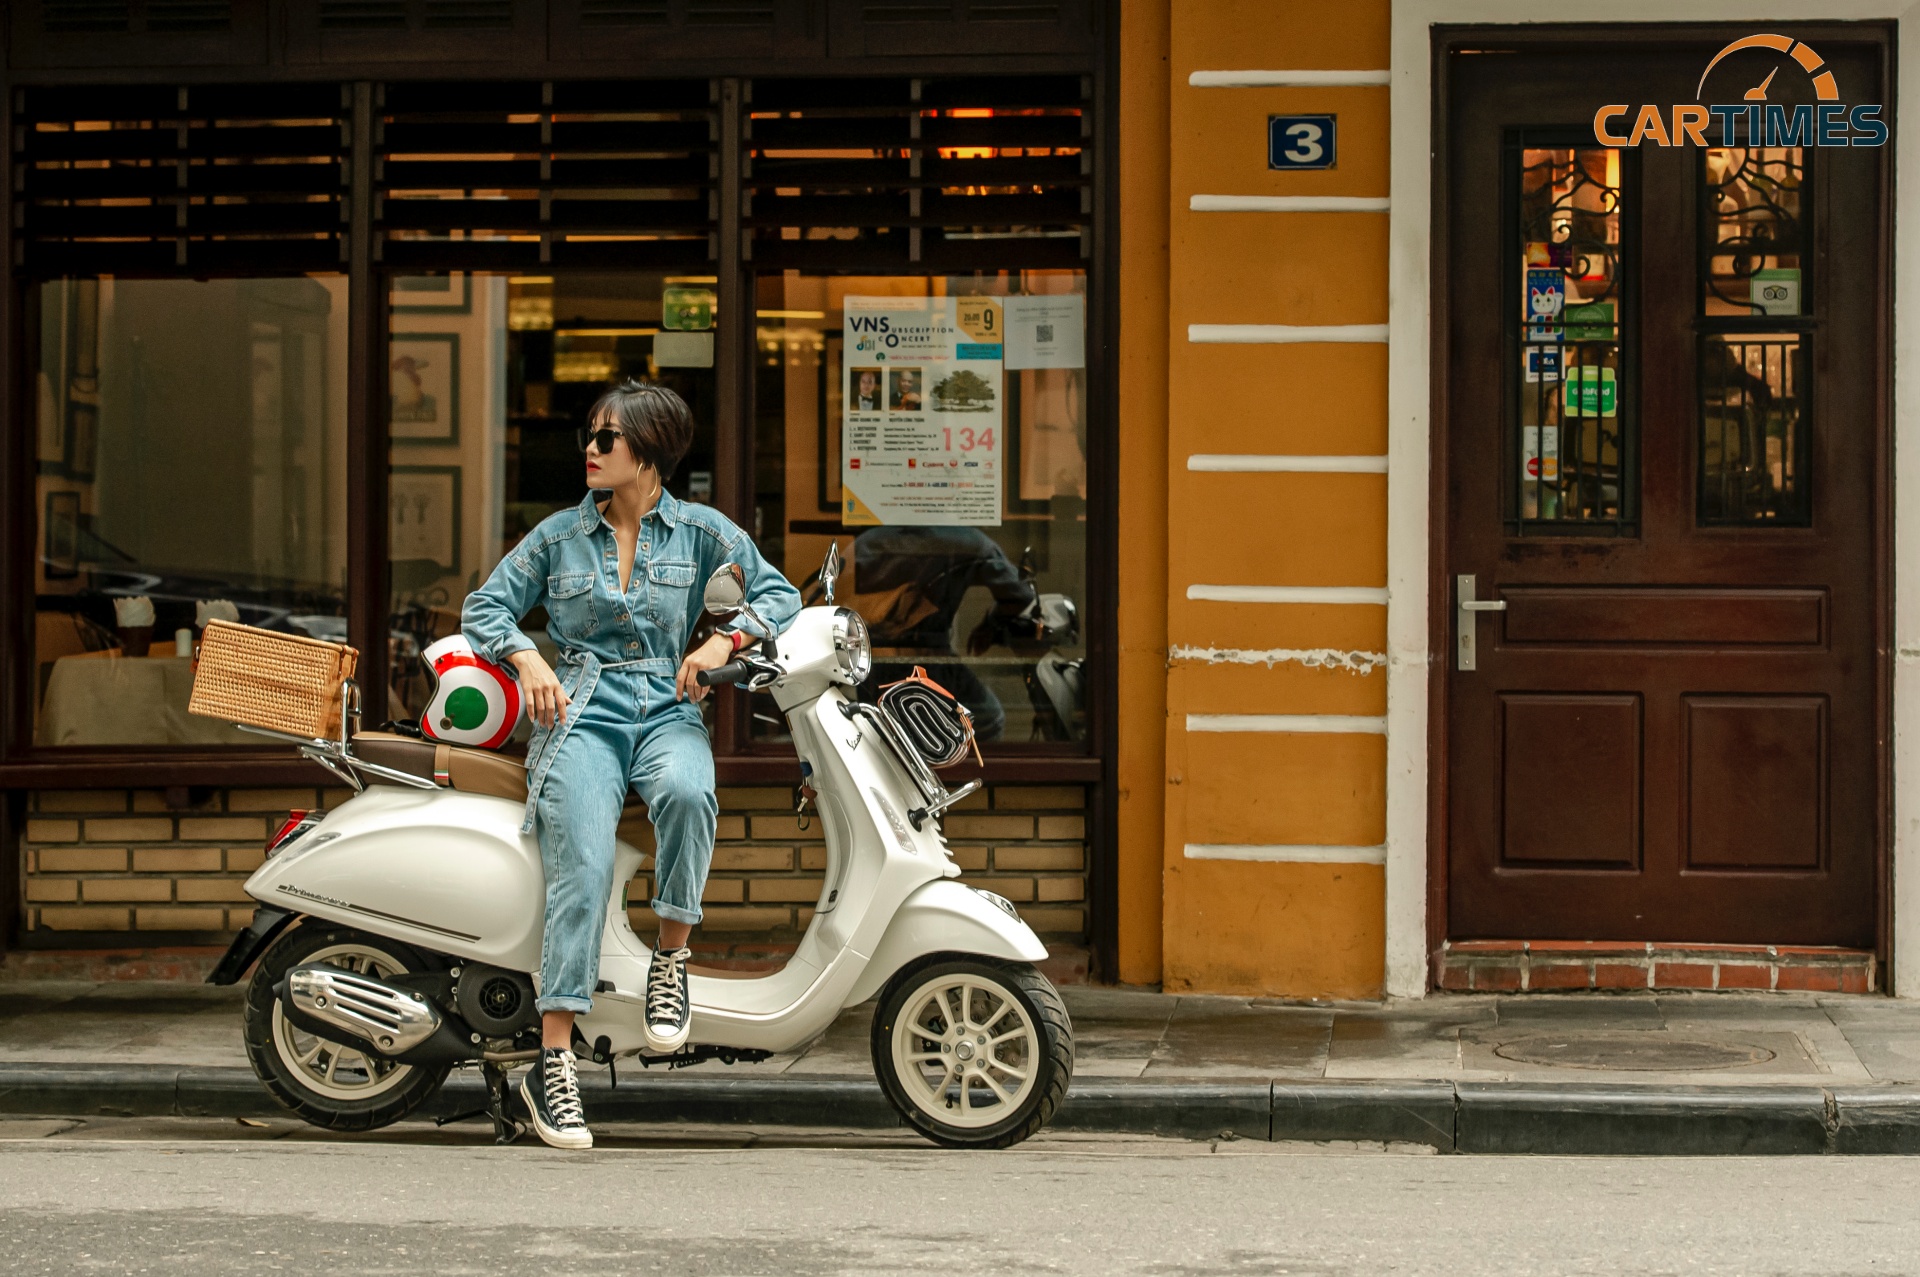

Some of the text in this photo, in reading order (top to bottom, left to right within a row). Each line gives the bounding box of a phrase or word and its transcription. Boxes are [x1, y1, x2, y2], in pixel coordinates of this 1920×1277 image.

[1284, 123, 1323, 163] 3
[984, 309, 994, 331] 9
[942, 427, 995, 452] 134
